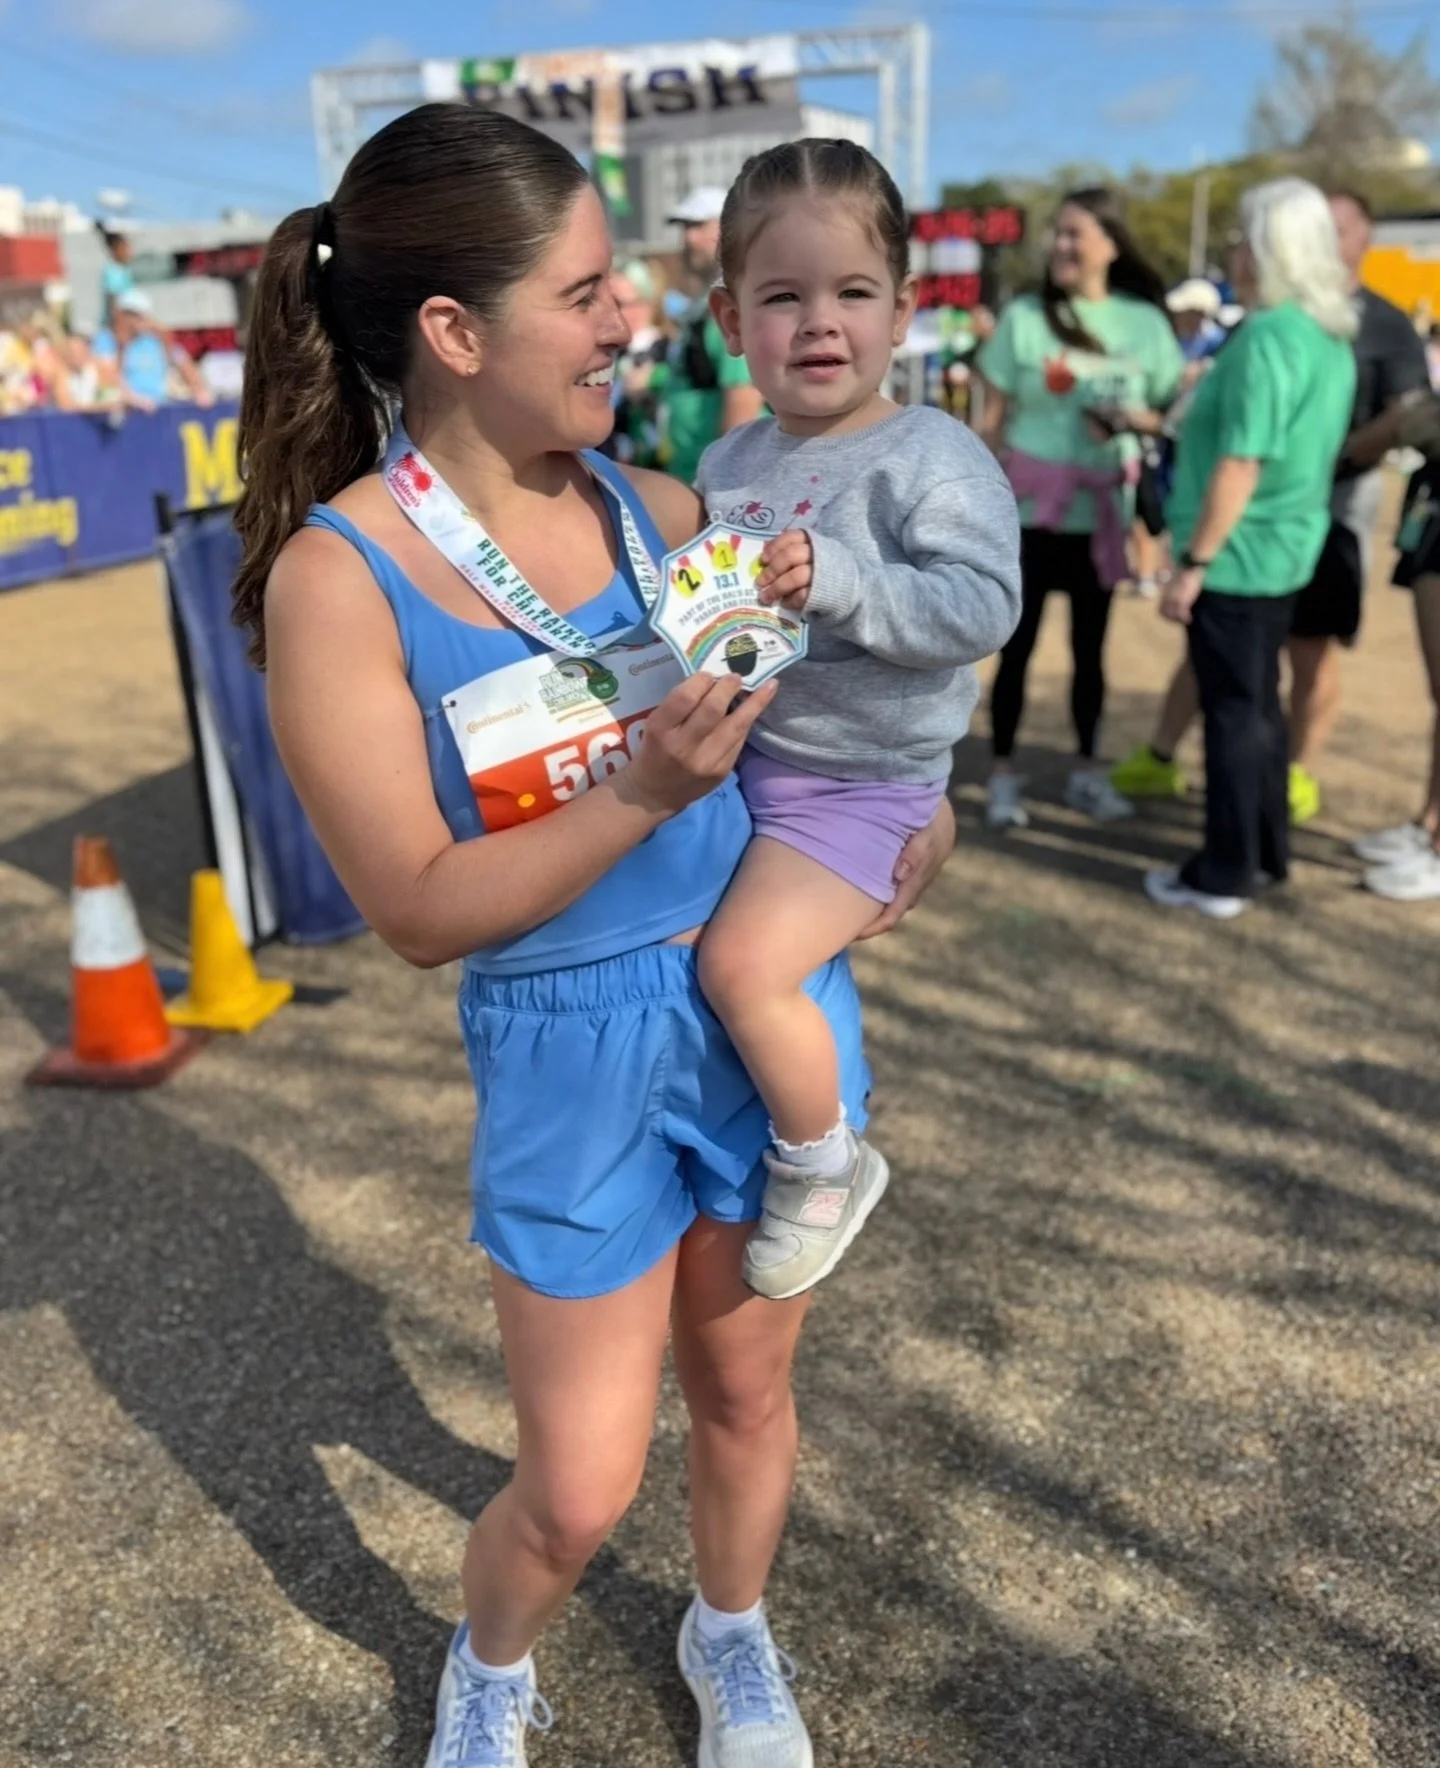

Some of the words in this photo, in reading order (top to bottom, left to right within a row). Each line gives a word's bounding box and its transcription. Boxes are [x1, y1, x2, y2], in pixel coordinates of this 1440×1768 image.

[461, 62, 766, 120] INISH
[717, 549, 733, 568] 1
[476, 557, 507, 587] FOR
[677, 568, 701, 591] 2
[713, 572, 740, 590] 13.1
[477, 538, 509, 571] RUN
[509, 574, 539, 604] THE
[539, 607, 597, 651] RAINBO
